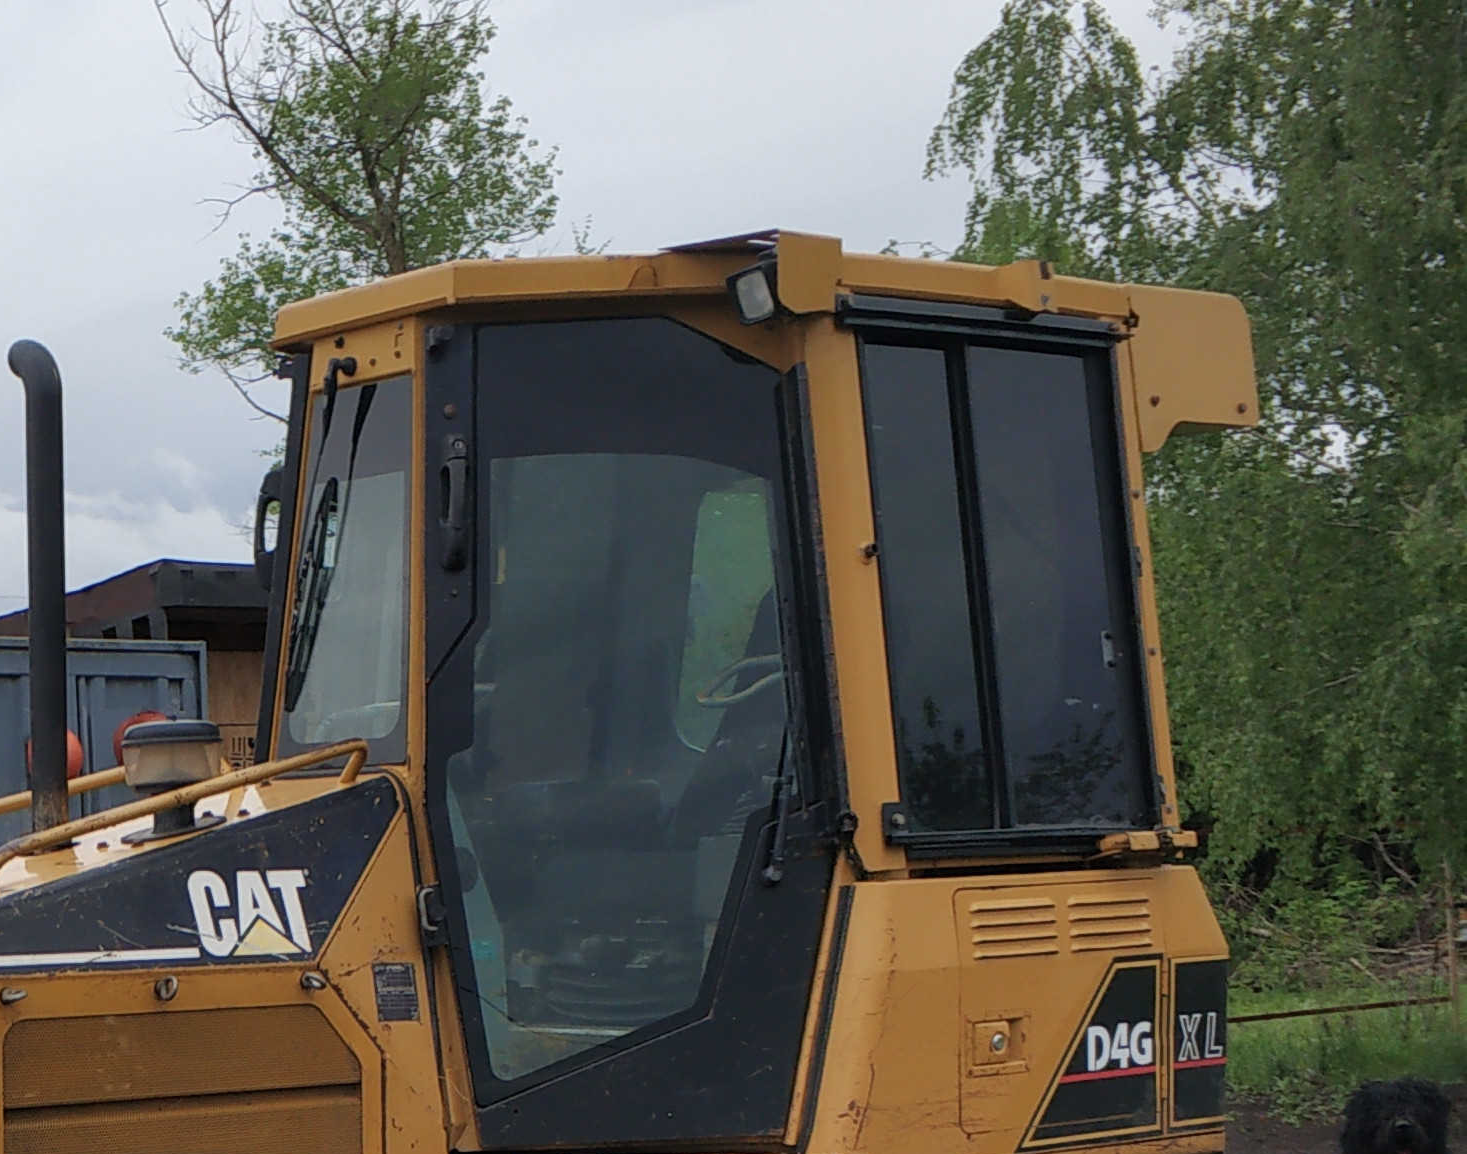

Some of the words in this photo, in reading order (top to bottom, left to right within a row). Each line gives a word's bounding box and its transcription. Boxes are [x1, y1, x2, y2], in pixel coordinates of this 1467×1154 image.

[187, 869, 313, 957] CAT
[1086, 1021, 1154, 1072] D4G
[1177, 1011, 1224, 1062] XL
